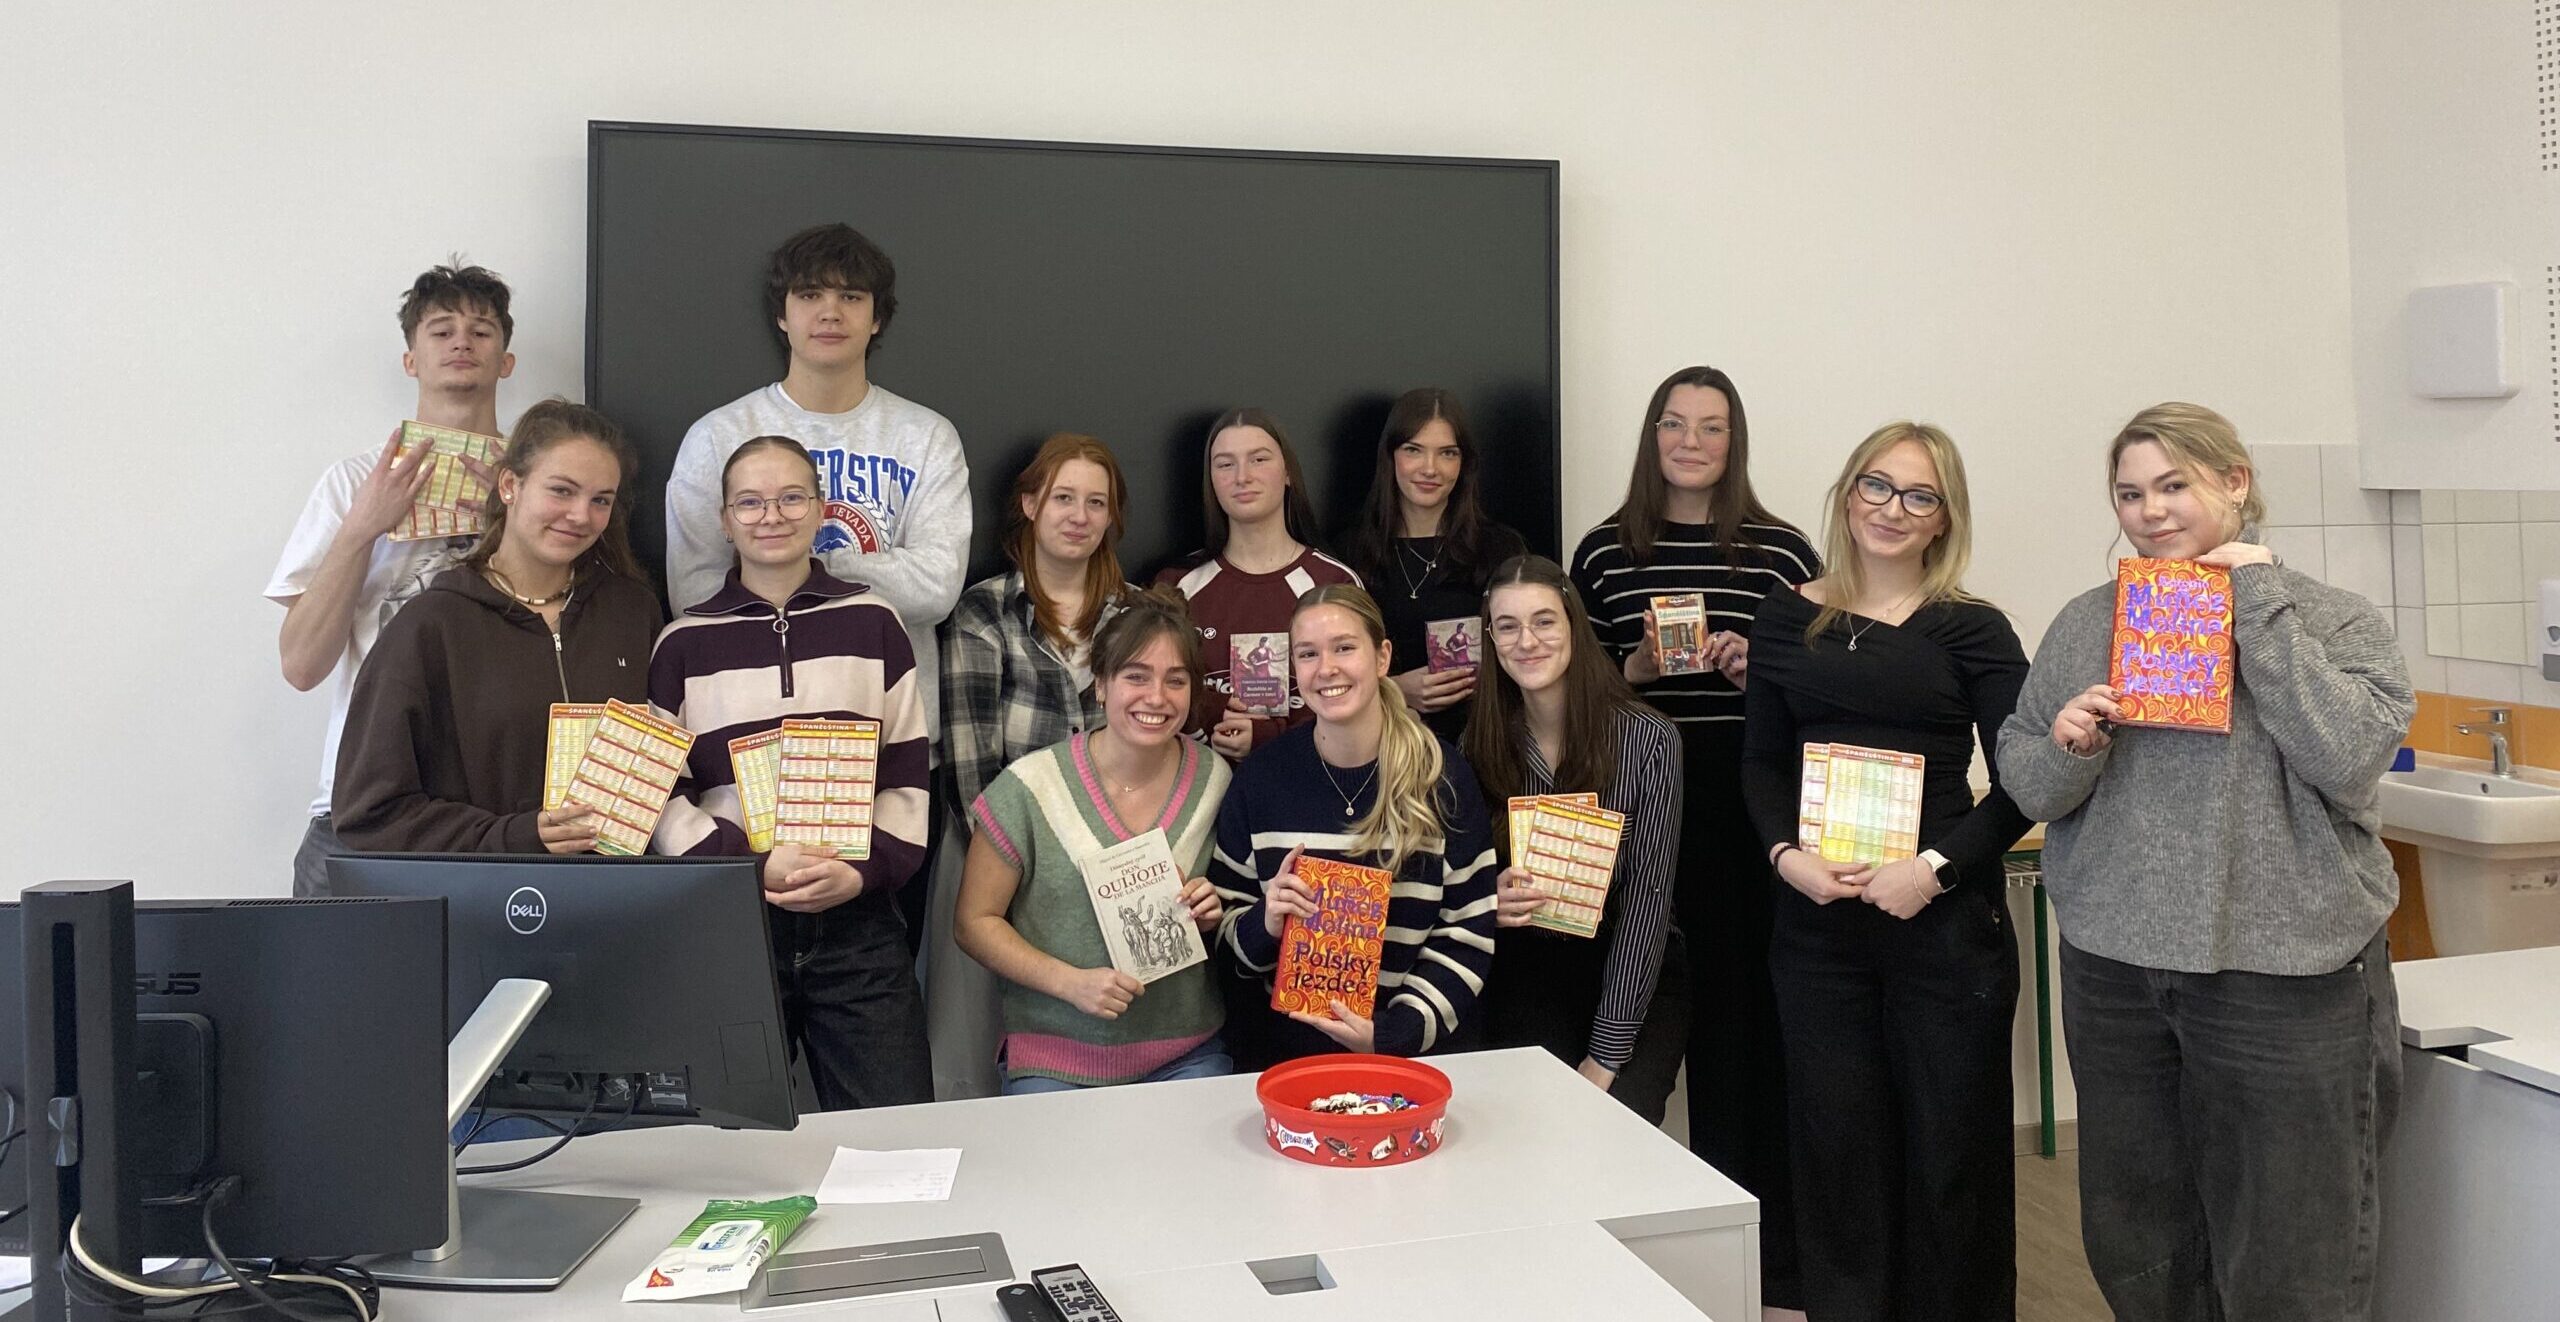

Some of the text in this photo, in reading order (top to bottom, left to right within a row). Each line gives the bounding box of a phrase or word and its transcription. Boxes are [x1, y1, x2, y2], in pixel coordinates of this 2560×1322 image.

[2127, 584, 2226, 613] Muñoz
[2126, 606, 2223, 635] Molina
[1098, 860, 1170, 899] QUIJOTE
[1121, 864, 1140, 876] DON
[1114, 876, 1166, 900] DE LA MANCHA
[511, 904, 543, 917] DELL
[1293, 941, 1373, 981] Polský
